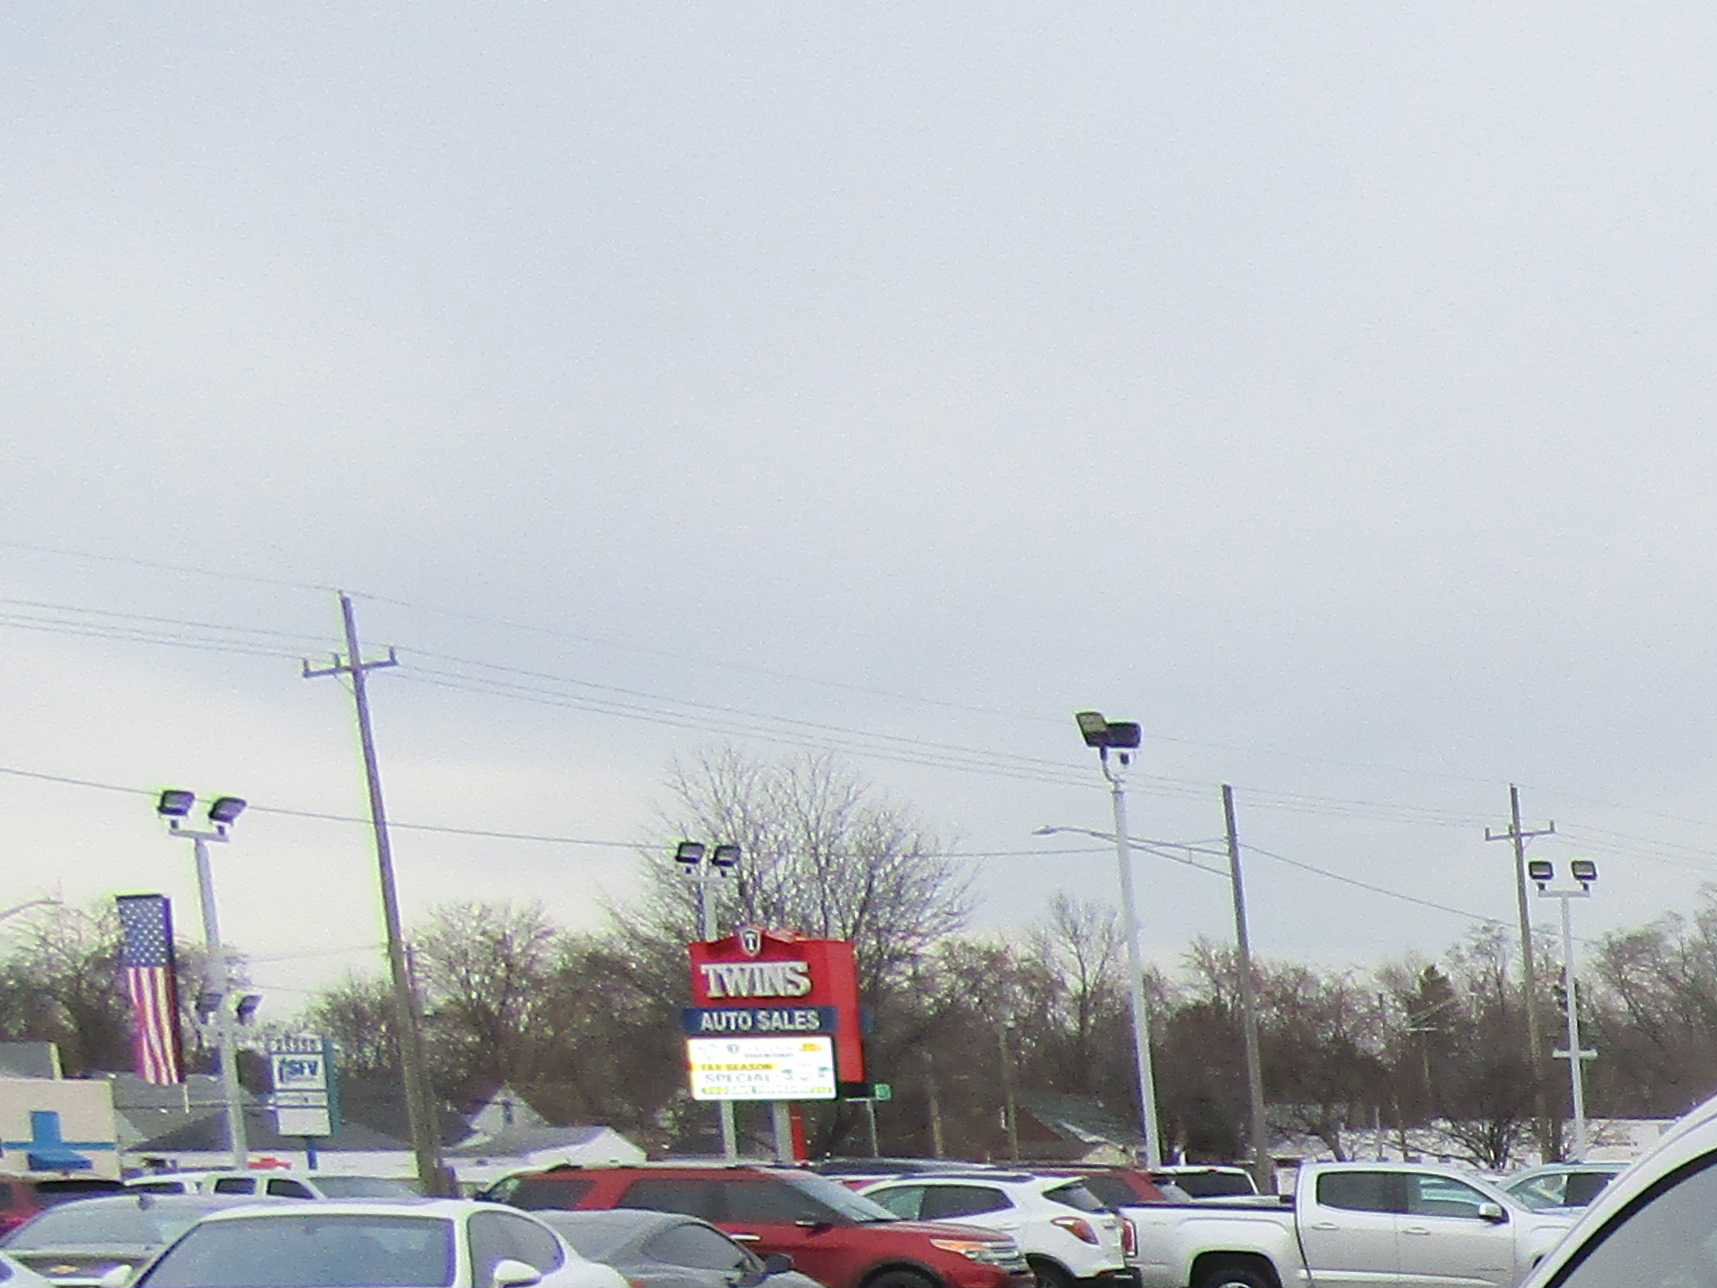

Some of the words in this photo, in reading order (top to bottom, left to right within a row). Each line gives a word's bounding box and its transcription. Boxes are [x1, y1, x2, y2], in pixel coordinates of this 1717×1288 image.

[700, 961, 812, 998] TWINS
[701, 1012, 751, 1031] AUTO
[758, 1010, 820, 1030] SALES
